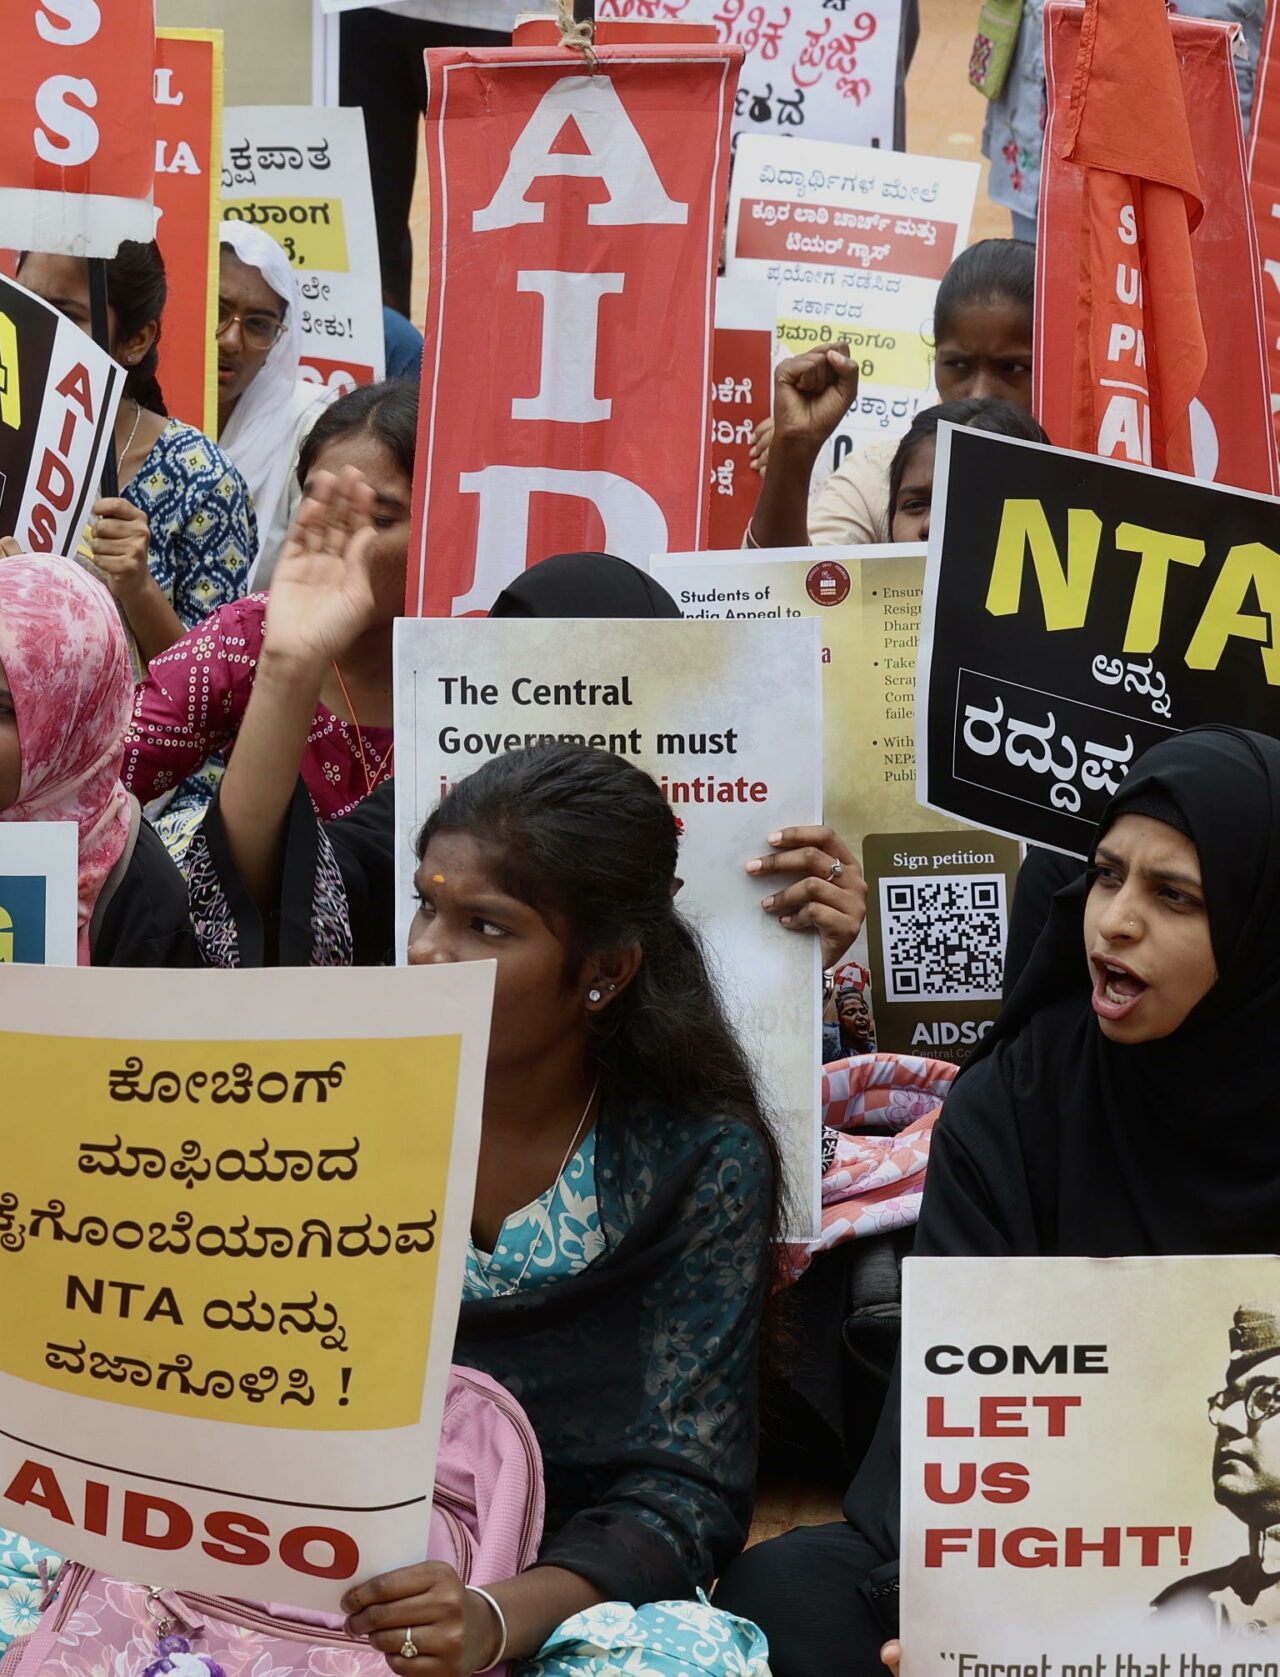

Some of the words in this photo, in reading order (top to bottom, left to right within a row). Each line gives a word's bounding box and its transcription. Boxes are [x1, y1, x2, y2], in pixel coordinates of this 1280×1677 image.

[681, 588, 750, 604] Students
[755, 586, 770, 601] of
[786, 607, 801, 618] to
[883, 588, 923, 599] Ensur
[985, 498, 1280, 686] NTA
[884, 657, 915, 668] Take
[438, 676, 498, 705] The
[511, 676, 633, 706] Central
[1091, 653, 1172, 718] ಅನ್ನು
[656, 728, 738, 755] must
[893, 852, 928, 870] Sign
[933, 850, 995, 870] petition
[108, 1056, 346, 1105] ಕೋಚಿಂಗ್
[78, 1134, 360, 1190] ಮಾಫಿಯಾದ
[66, 1275, 184, 1325] NTA
[203, 1289, 348, 1352] ಯನ್ನು
[45, 1340, 317, 1406] ವಜಾಗೊಳಿಸಿ
[924, 1344, 1109, 1375] COME
[926, 1396, 1081, 1437] LET
[924, 1462, 1030, 1504] US
[3, 1459, 360, 1581] AIDSO
[924, 1526, 1192, 1568] FIGHT!
